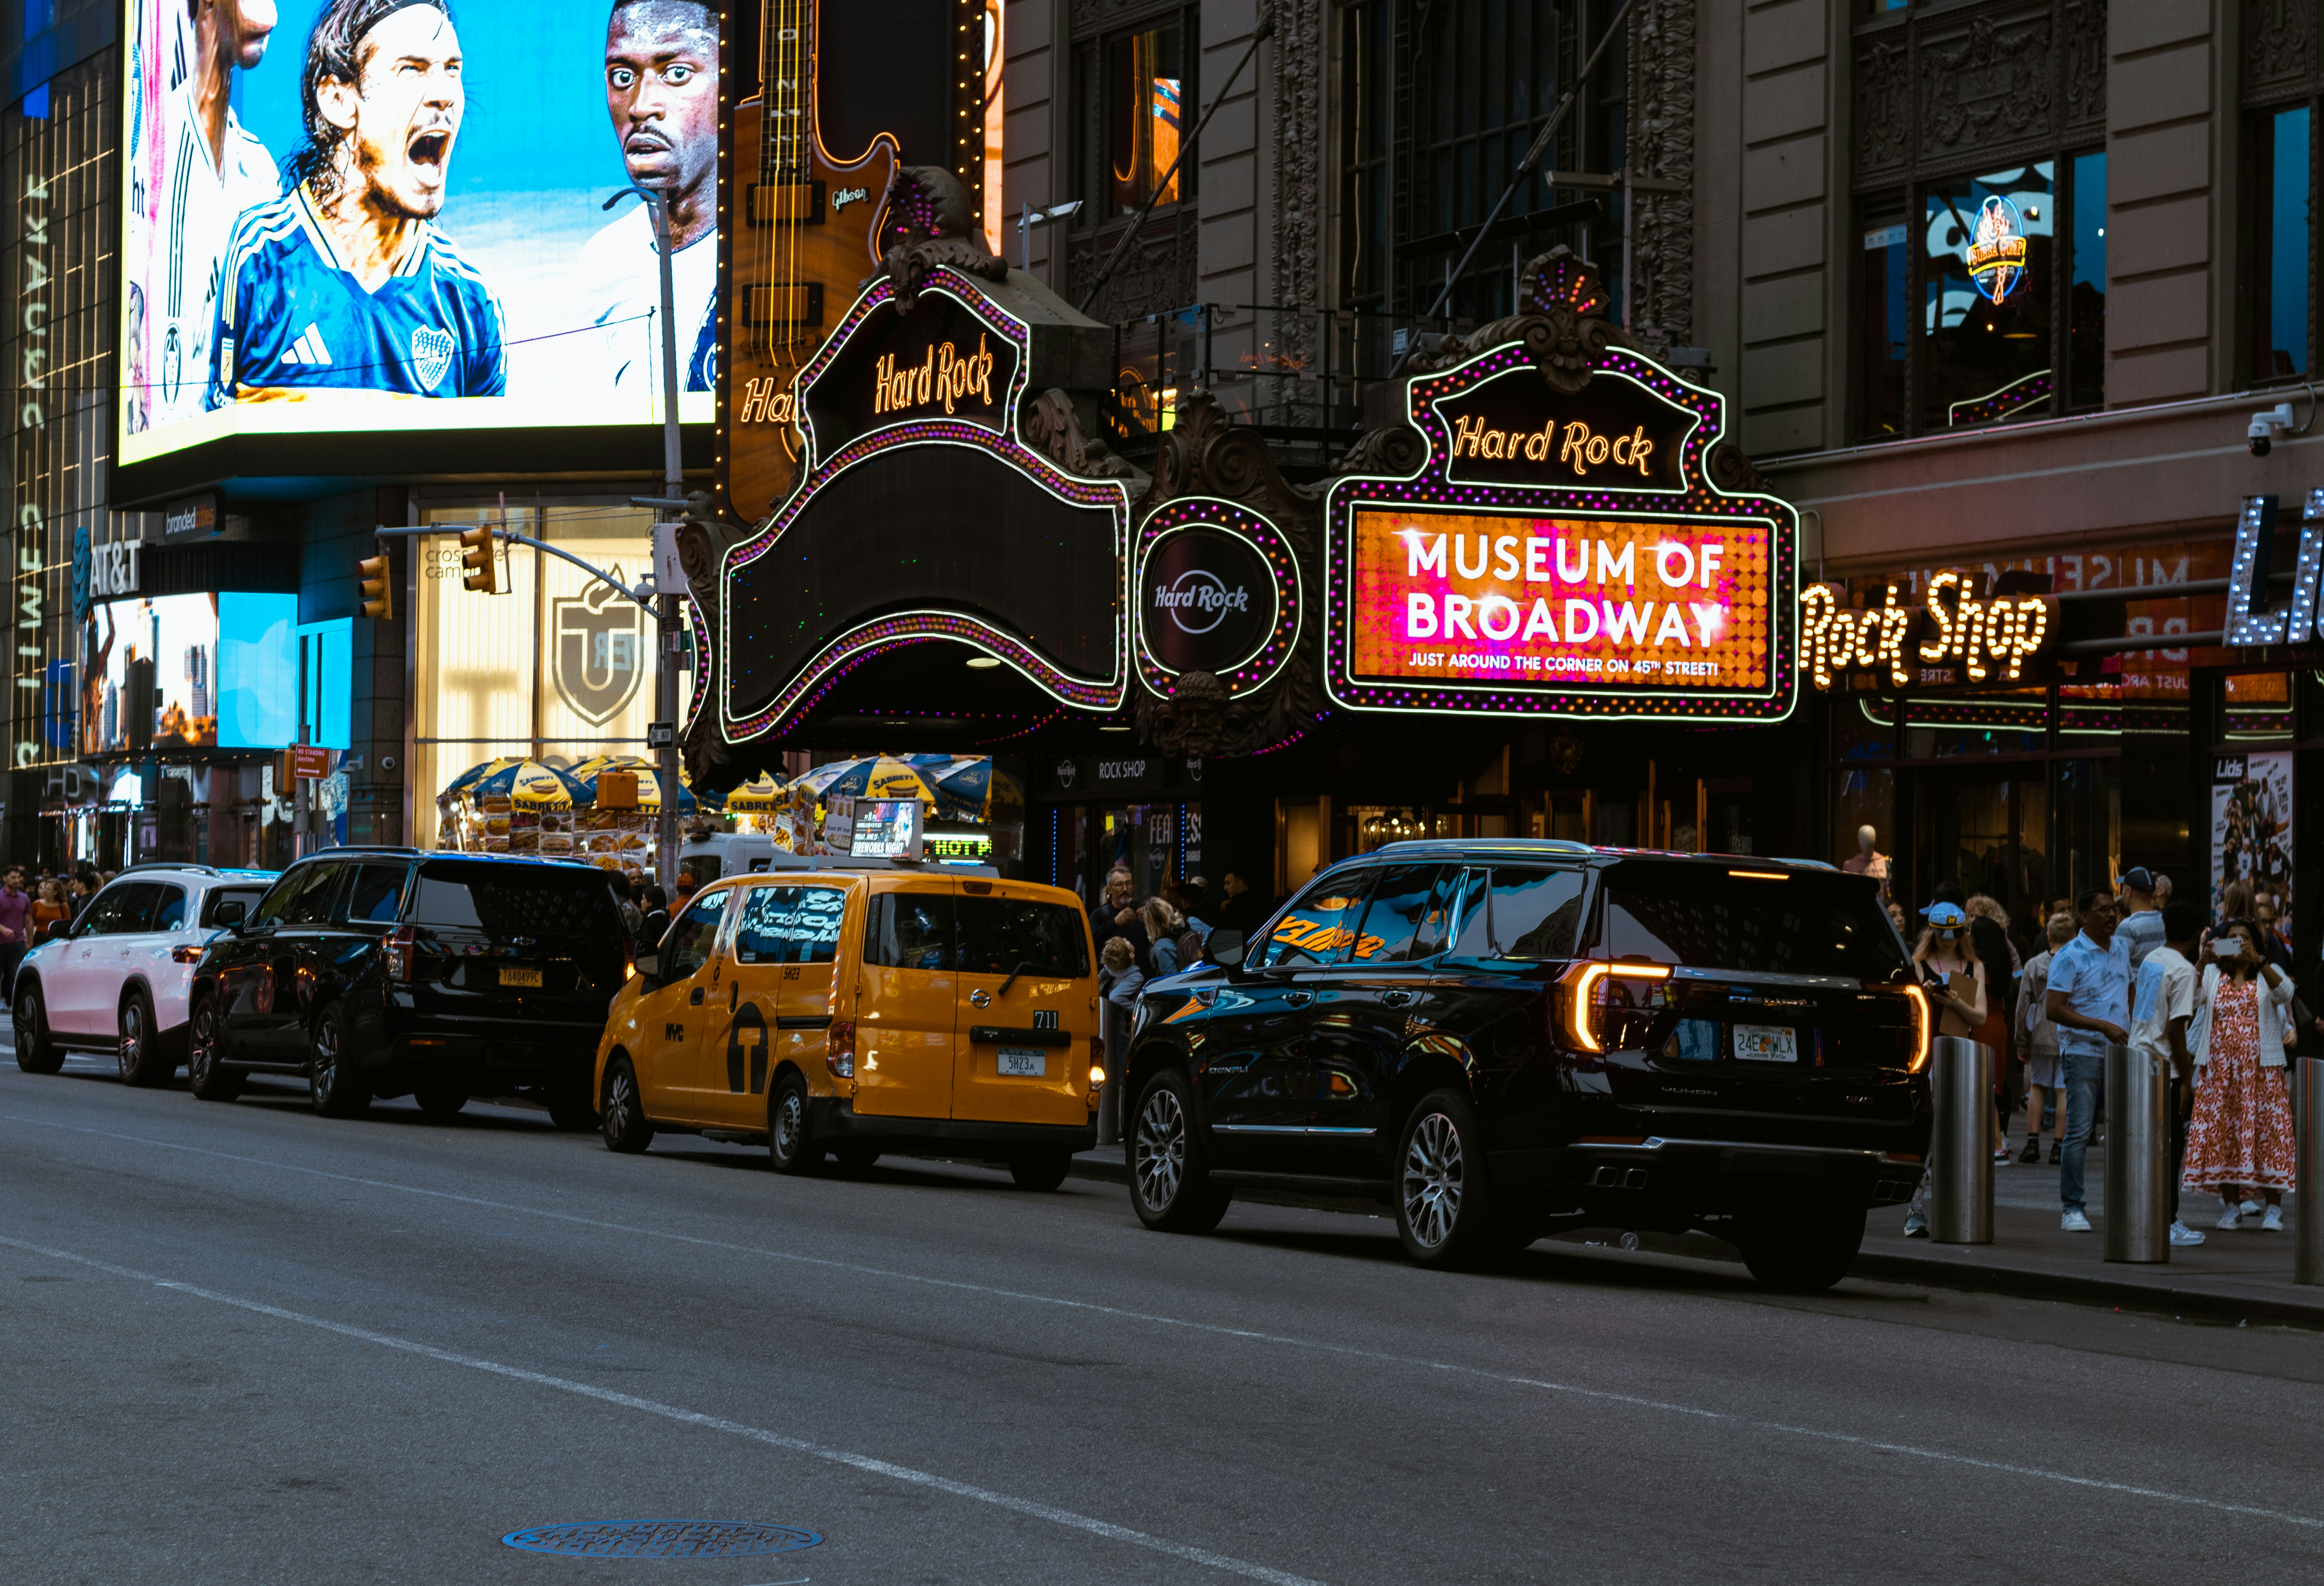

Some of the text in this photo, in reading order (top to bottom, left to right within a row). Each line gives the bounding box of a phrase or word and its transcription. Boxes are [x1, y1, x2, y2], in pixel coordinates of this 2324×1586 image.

[832, 188, 869, 210] Gibson
[1971, 240, 2023, 266] BUBBA GUMP
[875, 333, 993, 414] Hard Rock
[741, 377, 796, 423] Ha
[1454, 415, 1654, 476] Hard Rock
[89, 538, 141, 597] AT&T
[1408, 531, 1724, 589] MUSEUM OF
[1155, 585, 1249, 612] Hard Rock
[1406, 593, 1724, 648] BROADWAY
[1799, 581, 1909, 691] Rock
[1919, 567, 2047, 683] Shop
[1409, 652, 1445, 668] JUST
[1449, 653, 1511, 670] AROUND
[1515, 656, 1541, 670] THE
[1545, 656, 1603, 673] CORNER
[1607, 659, 1629, 673] ON
[1665, 661, 1719, 677] STREET!
[305, 748, 325, 757] STANDING
[1099, 760, 1146, 779] ROCK SHOP
[2216, 759, 2244, 778] Lids
[519, 775, 554, 786] SABRETT
[873, 775, 914, 789] SABRETT
[853, 841, 904, 854] FIREWORKS NIGHT
[935, 840, 974, 856] HOT
[1035, 1011, 1057, 1029] 711
[665, 1022, 683, 1042] NYC
[1209, 1066, 1249, 1074] DENALI
[1661, 1086, 1718, 1096] YUKON
[1845, 1095, 1874, 1104] GMC
